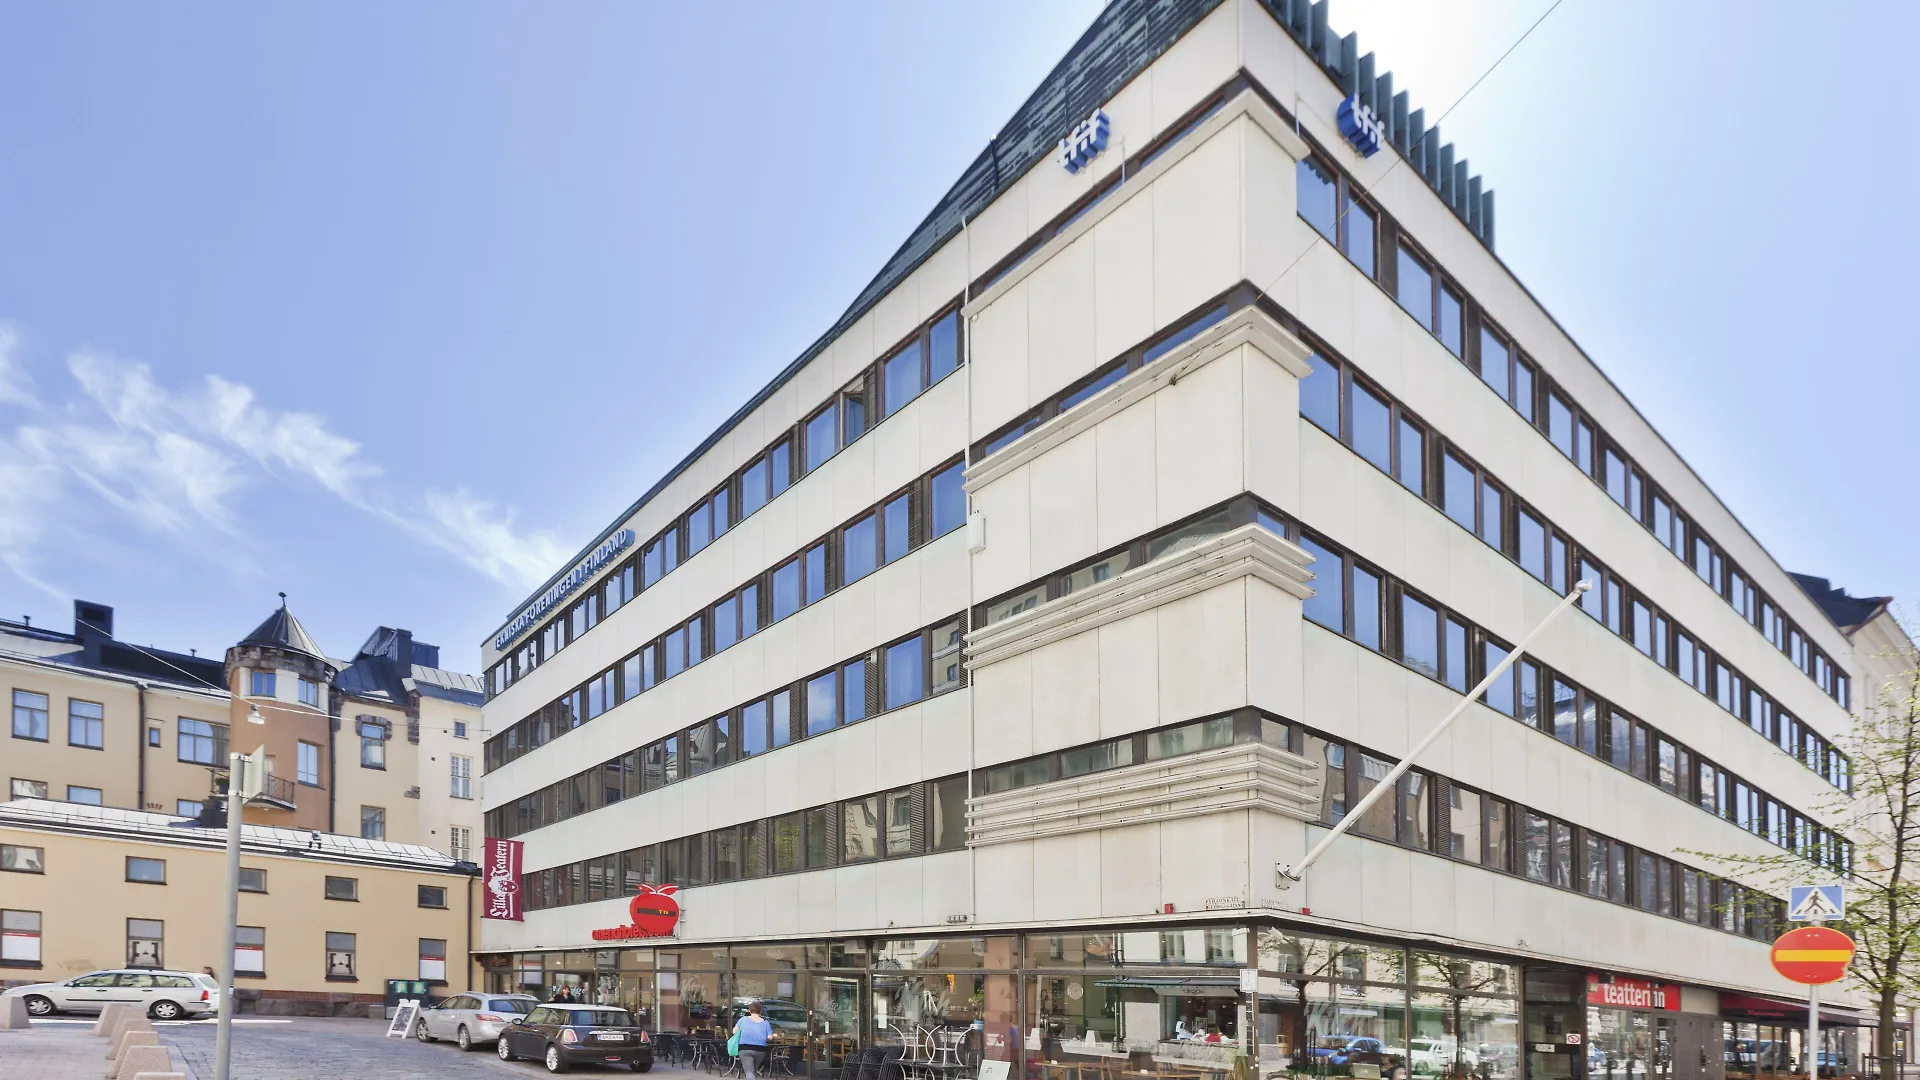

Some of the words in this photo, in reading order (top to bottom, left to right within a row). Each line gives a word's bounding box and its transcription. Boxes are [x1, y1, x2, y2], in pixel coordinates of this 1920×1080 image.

[585, 529, 630, 574] FINLAND
[1603, 982, 1651, 1007] teatteri
[1653, 983, 1665, 1008] in
